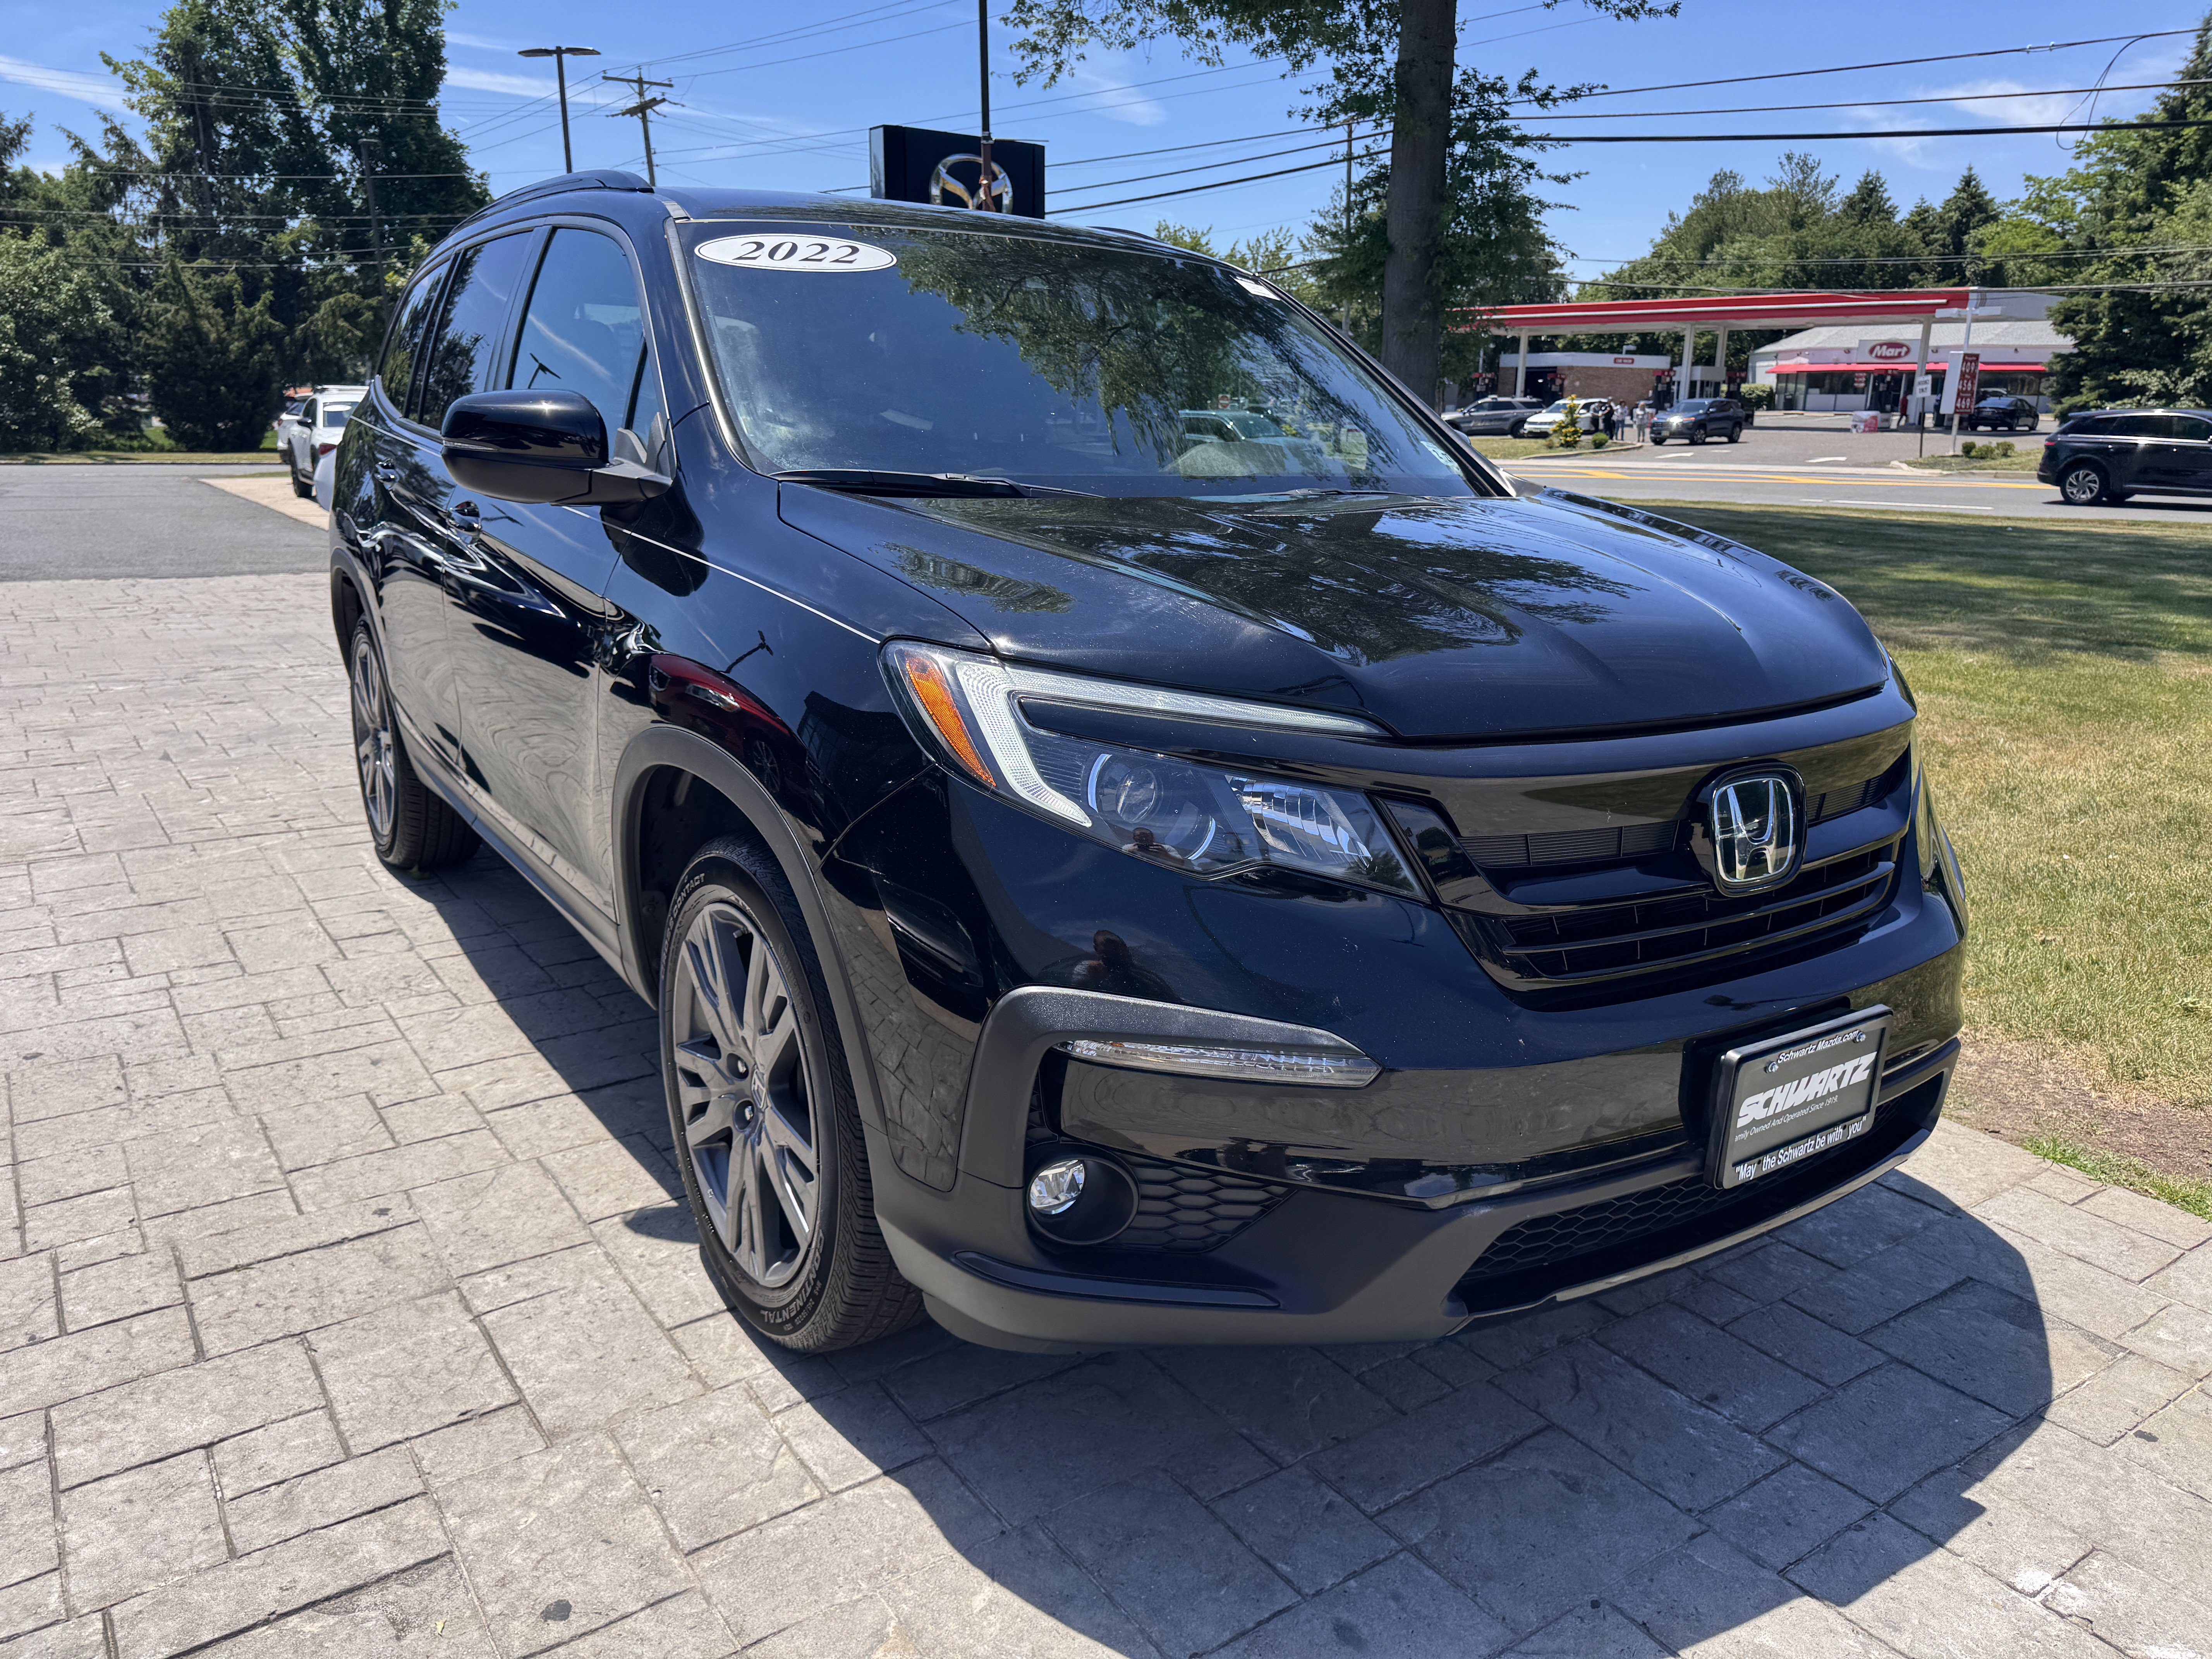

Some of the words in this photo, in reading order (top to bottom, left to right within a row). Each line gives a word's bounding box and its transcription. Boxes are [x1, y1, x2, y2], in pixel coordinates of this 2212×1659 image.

[732, 241, 860, 264] 2022
[1872, 345, 1907, 357] Mart
[1956, 397, 1971, 409] 469
[1959, 379, 1972, 391] 456
[673, 873, 705, 919] CONTACT
[1778, 1044, 1816, 1063] Schwartz
[1816, 1030, 1859, 1051] Mazda.com
[1737, 1051, 1877, 1128] SCHWARTZ
[1735, 1129, 1750, 1142] amily
[1750, 1122, 1771, 1136] Owned
[1771, 1118, 1783, 1128] And
[1783, 1107, 1809, 1123] Operated
[1809, 1103, 1824, 1112] Since
[1735, 1163, 1757, 1181] "May
[1762, 1155, 1776, 1171] the
[1777, 1139, 1814, 1165] Schwartz
[1815, 1132, 1825, 1149] be
[1827, 1125, 1843, 1144] with
[1847, 1115, 1867, 1140] you"
[760, 1229, 824, 1323] CONTINENTAL
